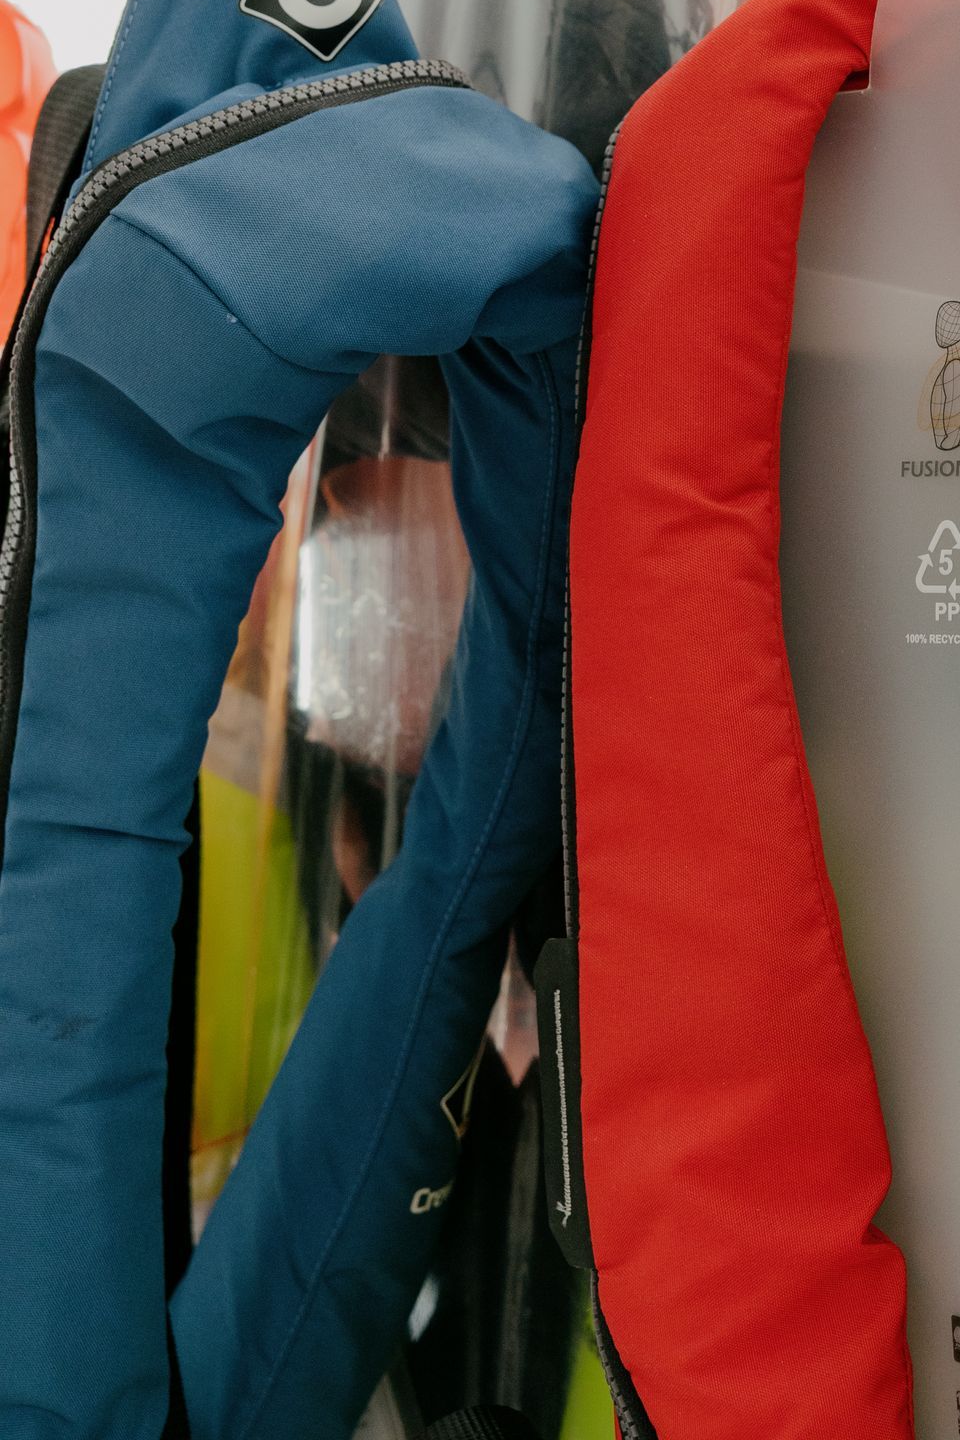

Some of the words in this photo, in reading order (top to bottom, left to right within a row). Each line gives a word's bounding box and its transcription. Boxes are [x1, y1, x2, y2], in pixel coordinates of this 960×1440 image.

[938, 549, 953, 576] 5
[935, 602, 960, 621] PP
[905, 634, 927, 644] 100%
